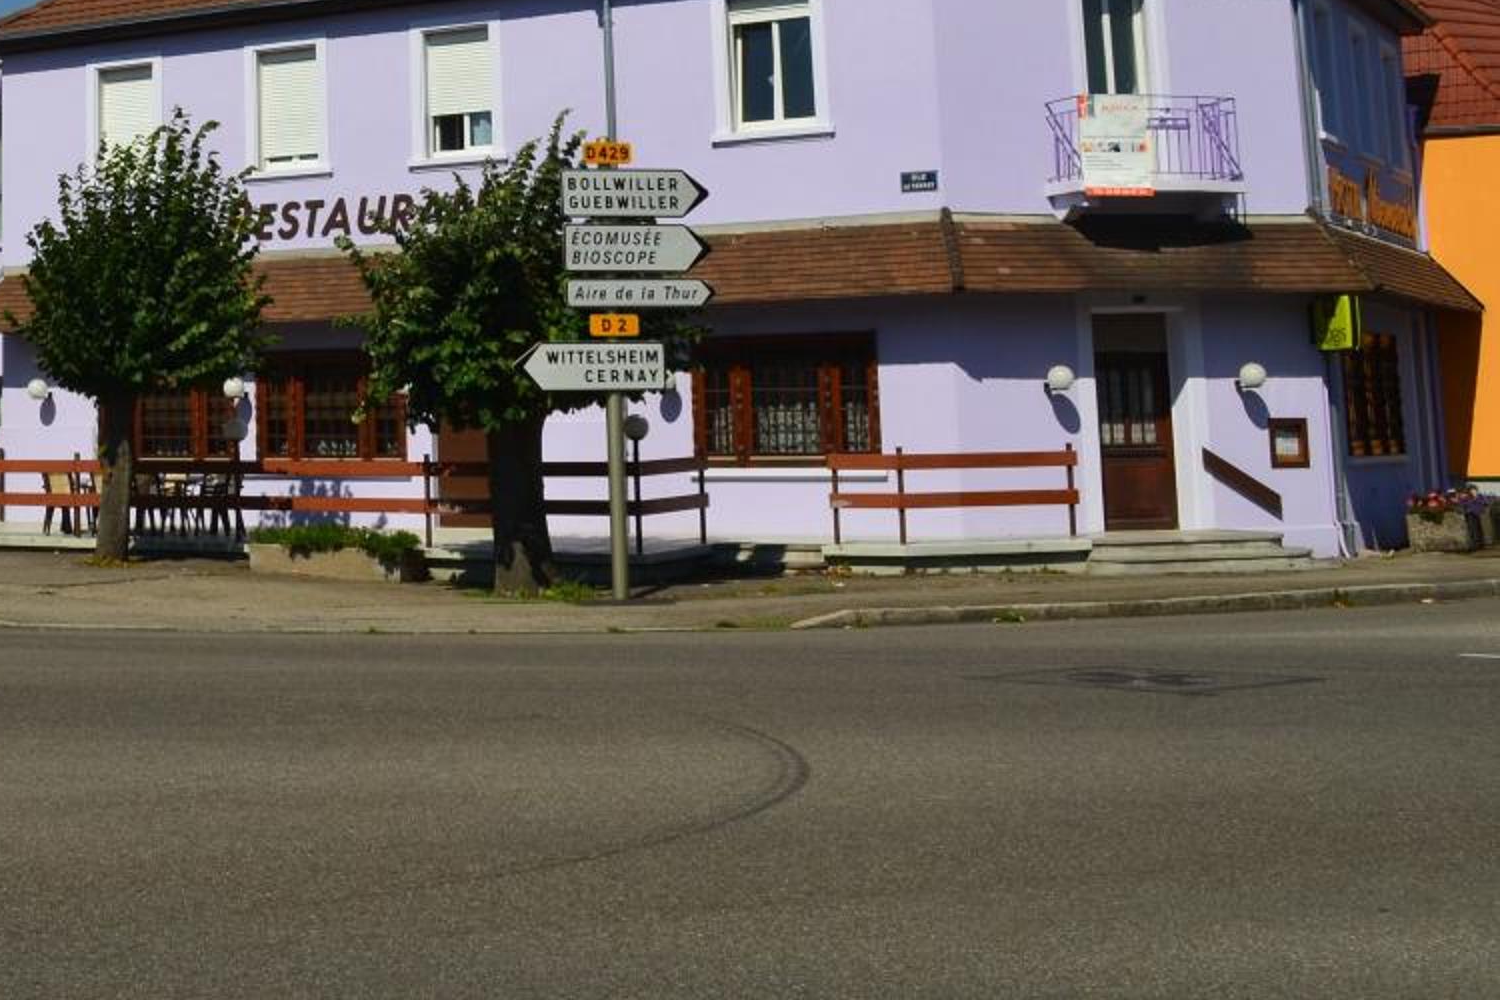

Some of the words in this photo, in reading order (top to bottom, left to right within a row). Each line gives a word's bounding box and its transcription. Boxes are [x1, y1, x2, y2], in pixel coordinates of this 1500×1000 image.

[567, 177, 678, 191] BOLLWILLER
[568, 195, 679, 209] GUEBWILLER
[228, 186, 488, 241] ESTAUR
[571, 229, 662, 246] ÉCOMUSÉE
[571, 250, 657, 265] BIOSCOPE
[574, 286, 607, 300] Aire
[615, 286, 633, 300] de
[641, 286, 656, 300] la
[664, 286, 699, 300] Thur
[546, 350, 660, 365] WITTELSHEIM
[584, 369, 660, 383] CERNAY
